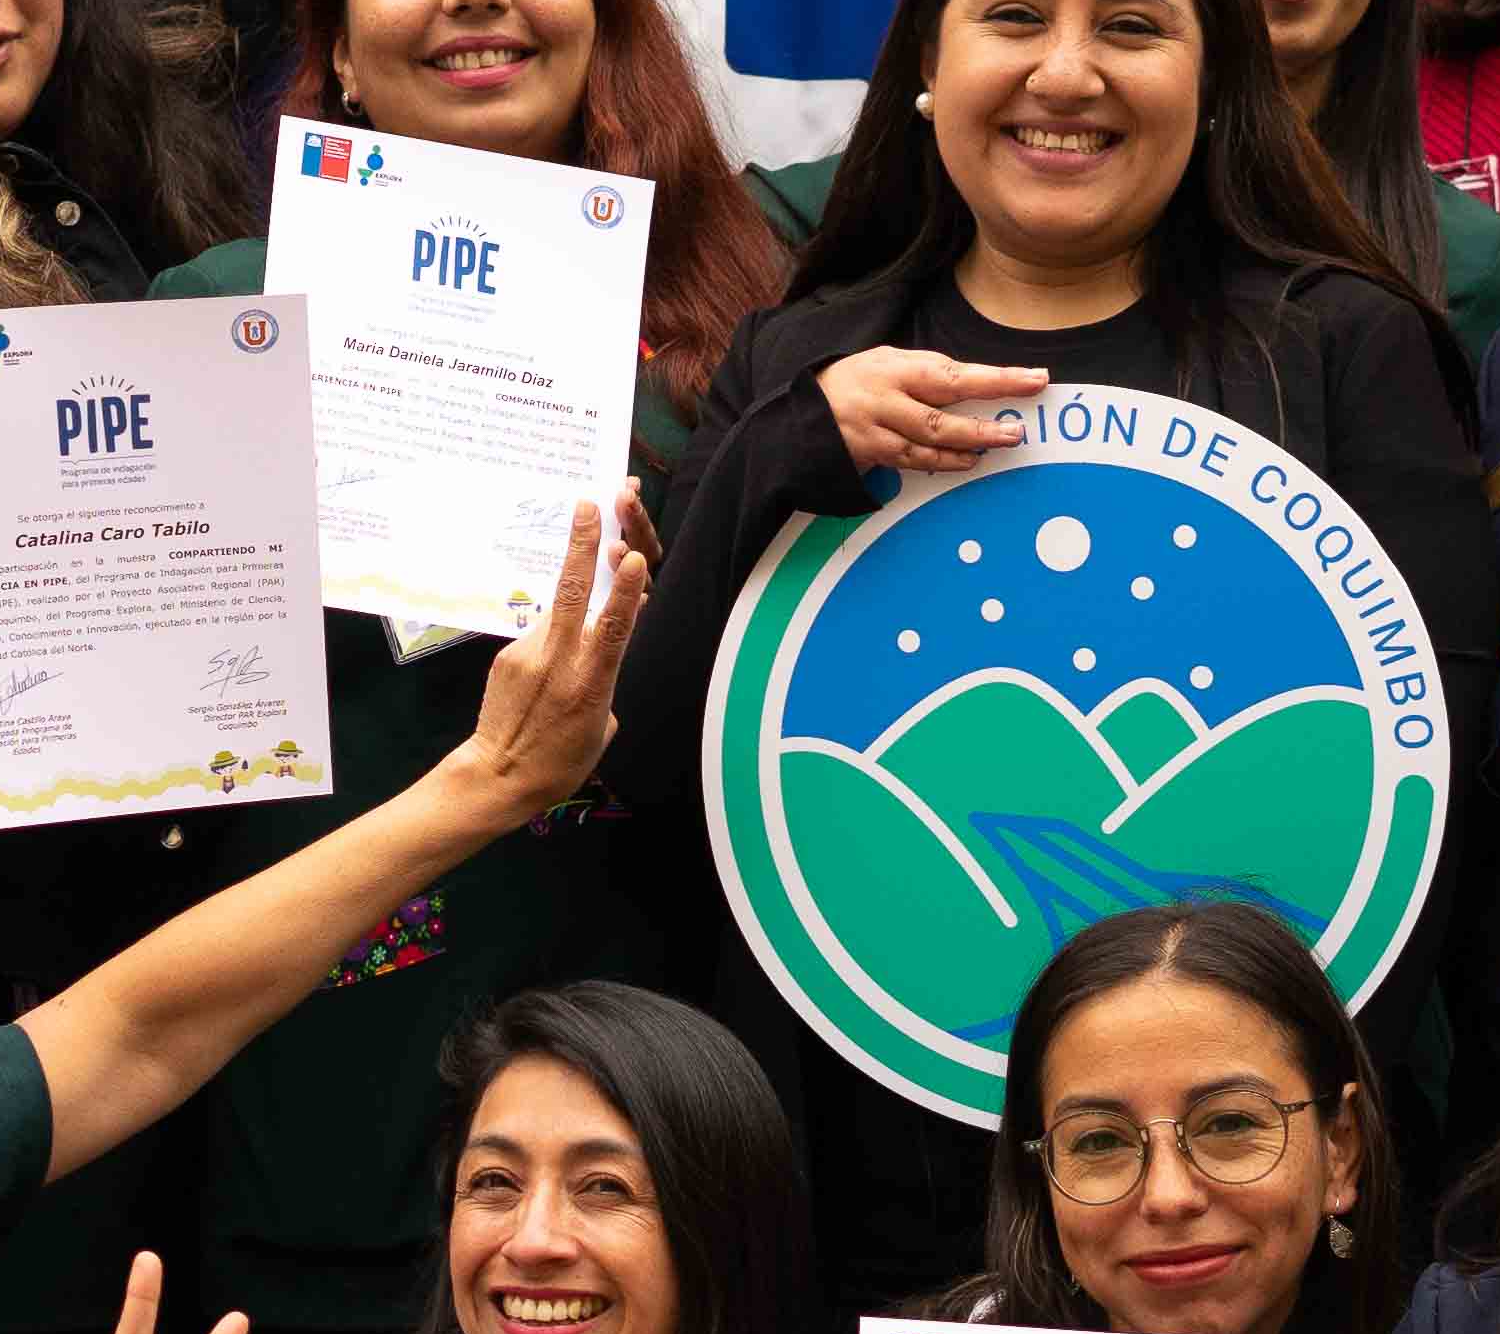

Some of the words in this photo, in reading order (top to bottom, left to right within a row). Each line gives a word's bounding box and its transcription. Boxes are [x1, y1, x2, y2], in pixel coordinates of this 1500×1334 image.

[412, 229, 500, 295] PIPE
[388, 345, 444, 368] Daniela
[448, 358, 517, 381] Jaramillo
[56, 393, 154, 456] PIPE
[15, 530, 94, 548] Catalina
[100, 527, 145, 541] Caro
[151, 520, 210, 538] Tabilo
[168, 545, 256, 560] COMPARTIENDO
[268, 543, 283, 552] MI
[23, 579, 38, 588] EN
[1161, 416, 1239, 478] DE
[1250, 464, 1434, 750] COQUIMBO
